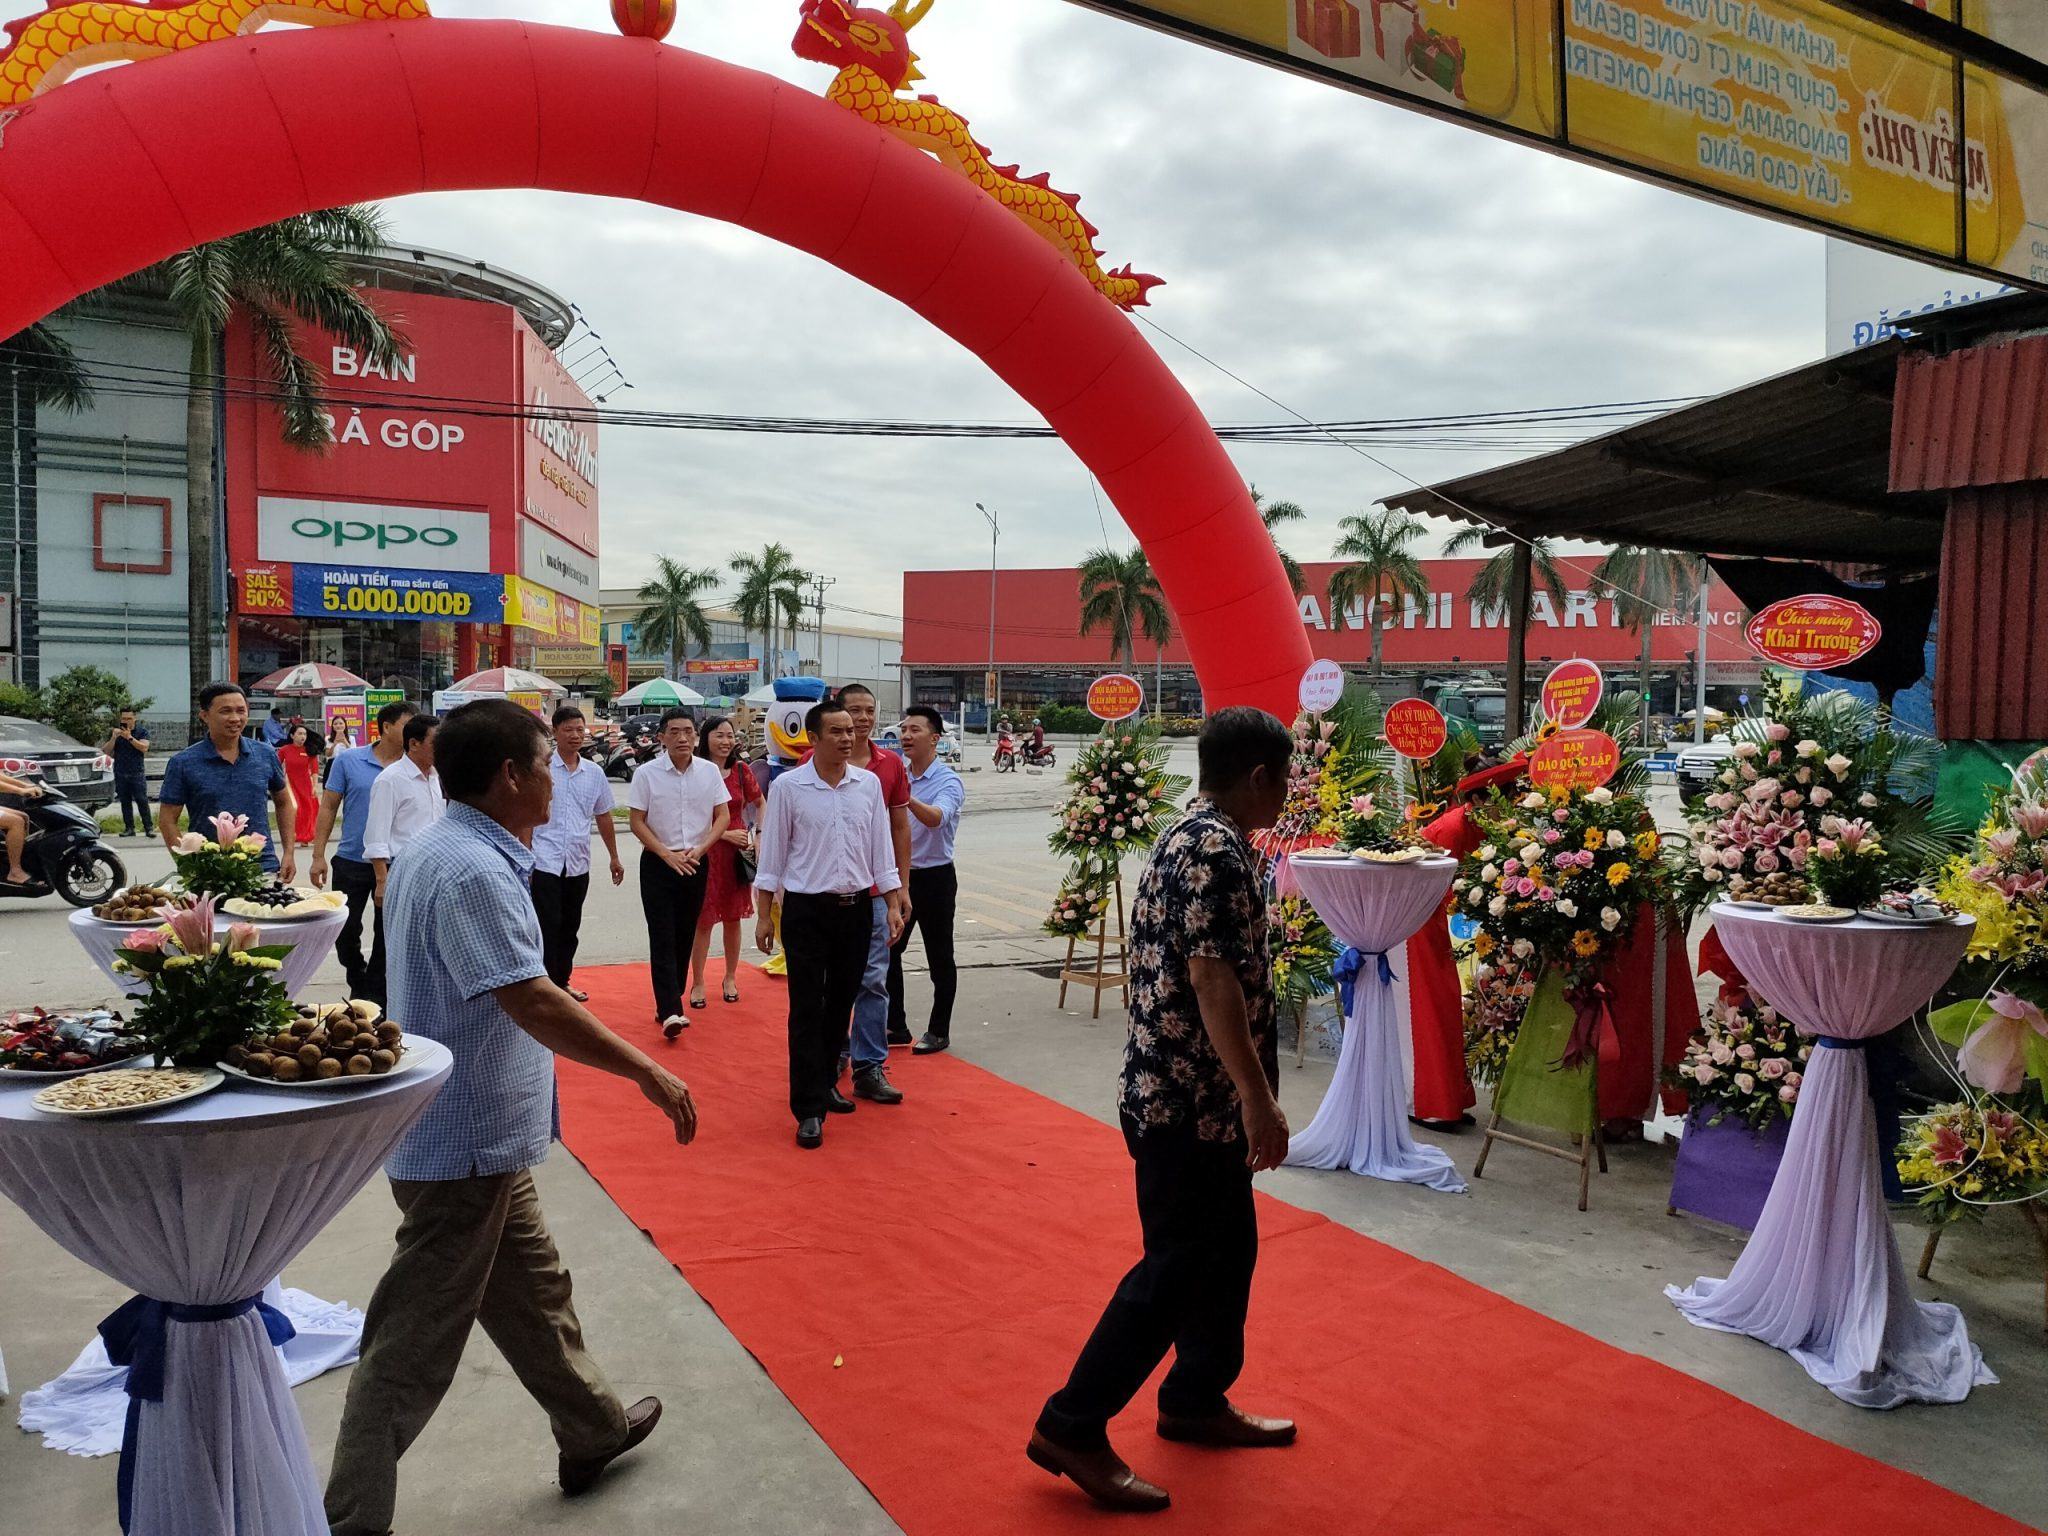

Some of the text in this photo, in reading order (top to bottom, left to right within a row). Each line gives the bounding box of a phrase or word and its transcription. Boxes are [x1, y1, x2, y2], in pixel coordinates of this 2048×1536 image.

[380, 418, 466, 452] GÓP
[246, 574, 278, 589] SALE
[323, 570, 358, 585] HOÀN
[391, 580, 410, 588] mua
[412, 577, 430, 589] sắm
[246, 589, 285, 607] 50%
[322, 586, 472, 616] 5.000.000Đ
[1776, 608, 1854, 632] Chúc mừng
[1764, 627, 1861, 655] Khai Trương
[1590, 752, 1612, 768] LẬP
